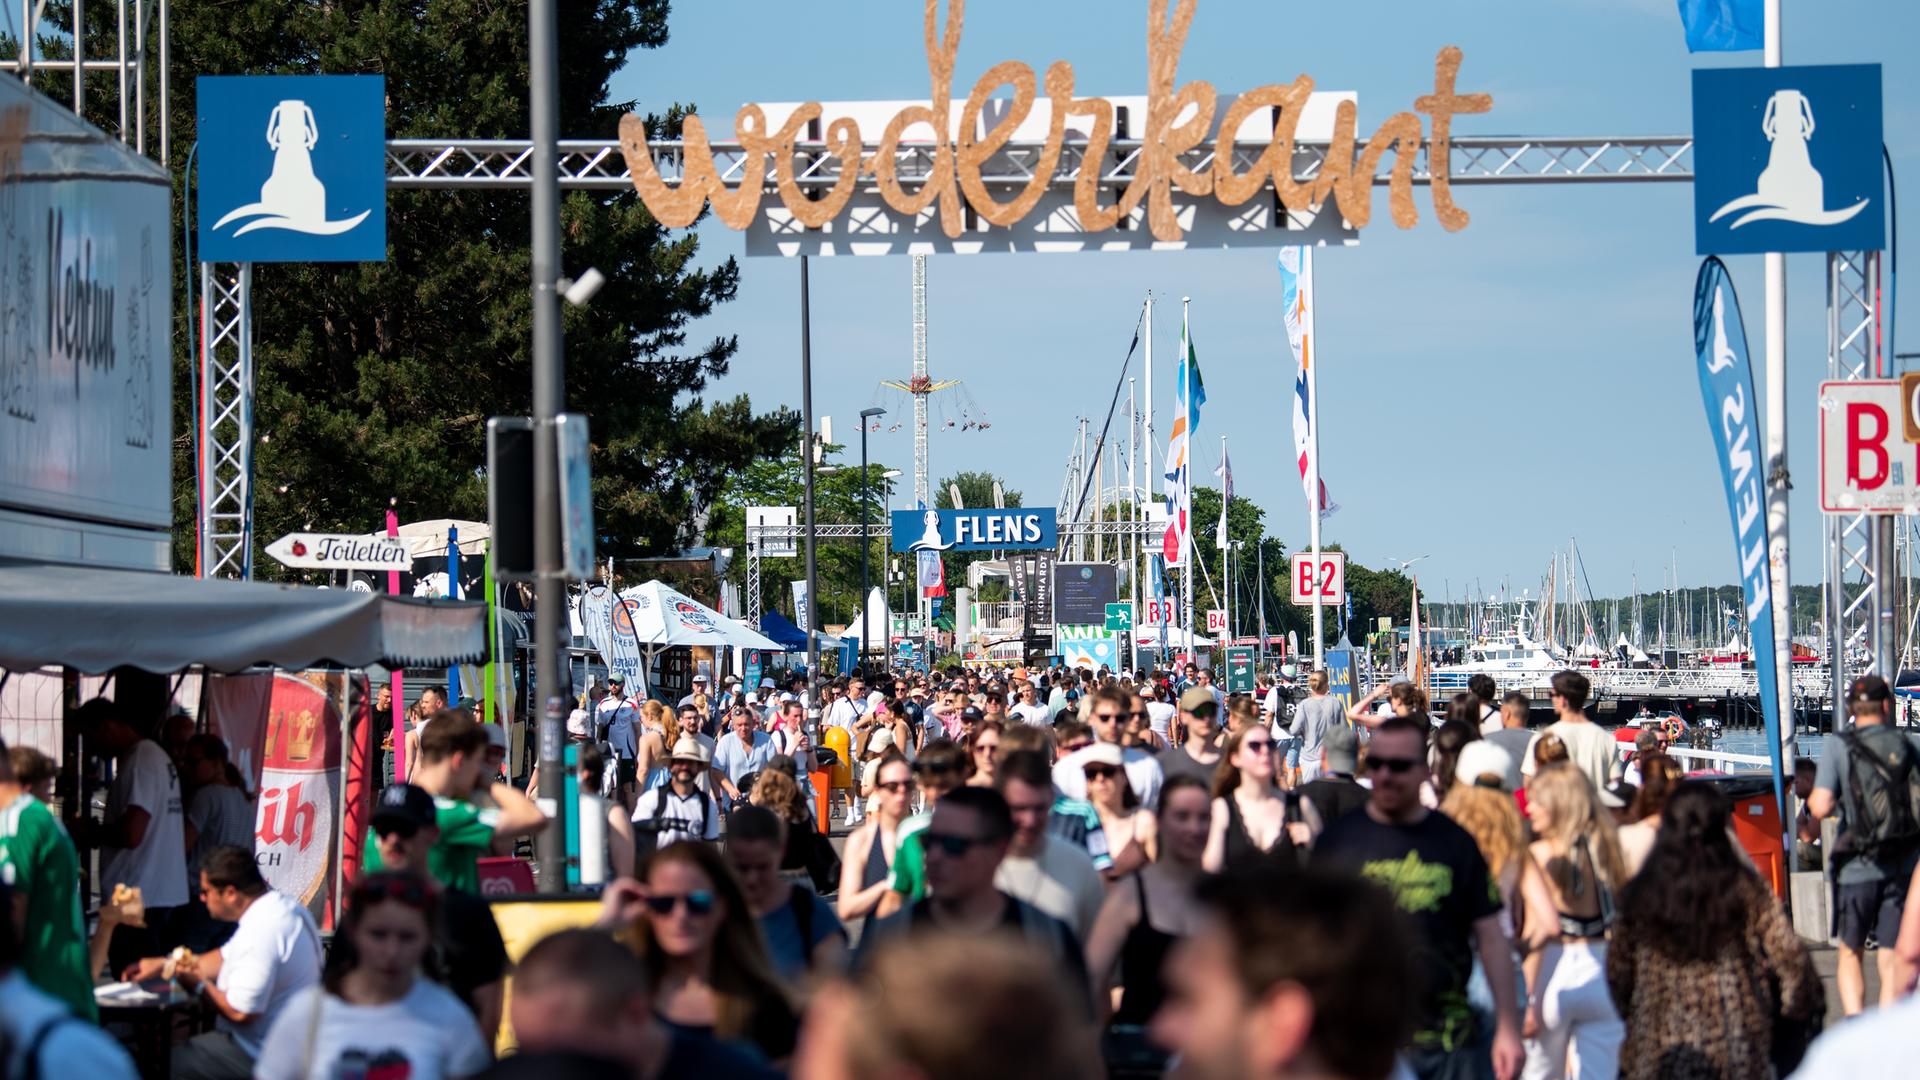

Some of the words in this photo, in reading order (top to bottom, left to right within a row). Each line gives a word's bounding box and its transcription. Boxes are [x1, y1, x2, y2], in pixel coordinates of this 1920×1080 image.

[955, 514, 1042, 543] FLENS
[318, 537, 405, 562] Toiletten
[1299, 561, 1336, 596] B2
[1209, 613, 1225, 629] B4
